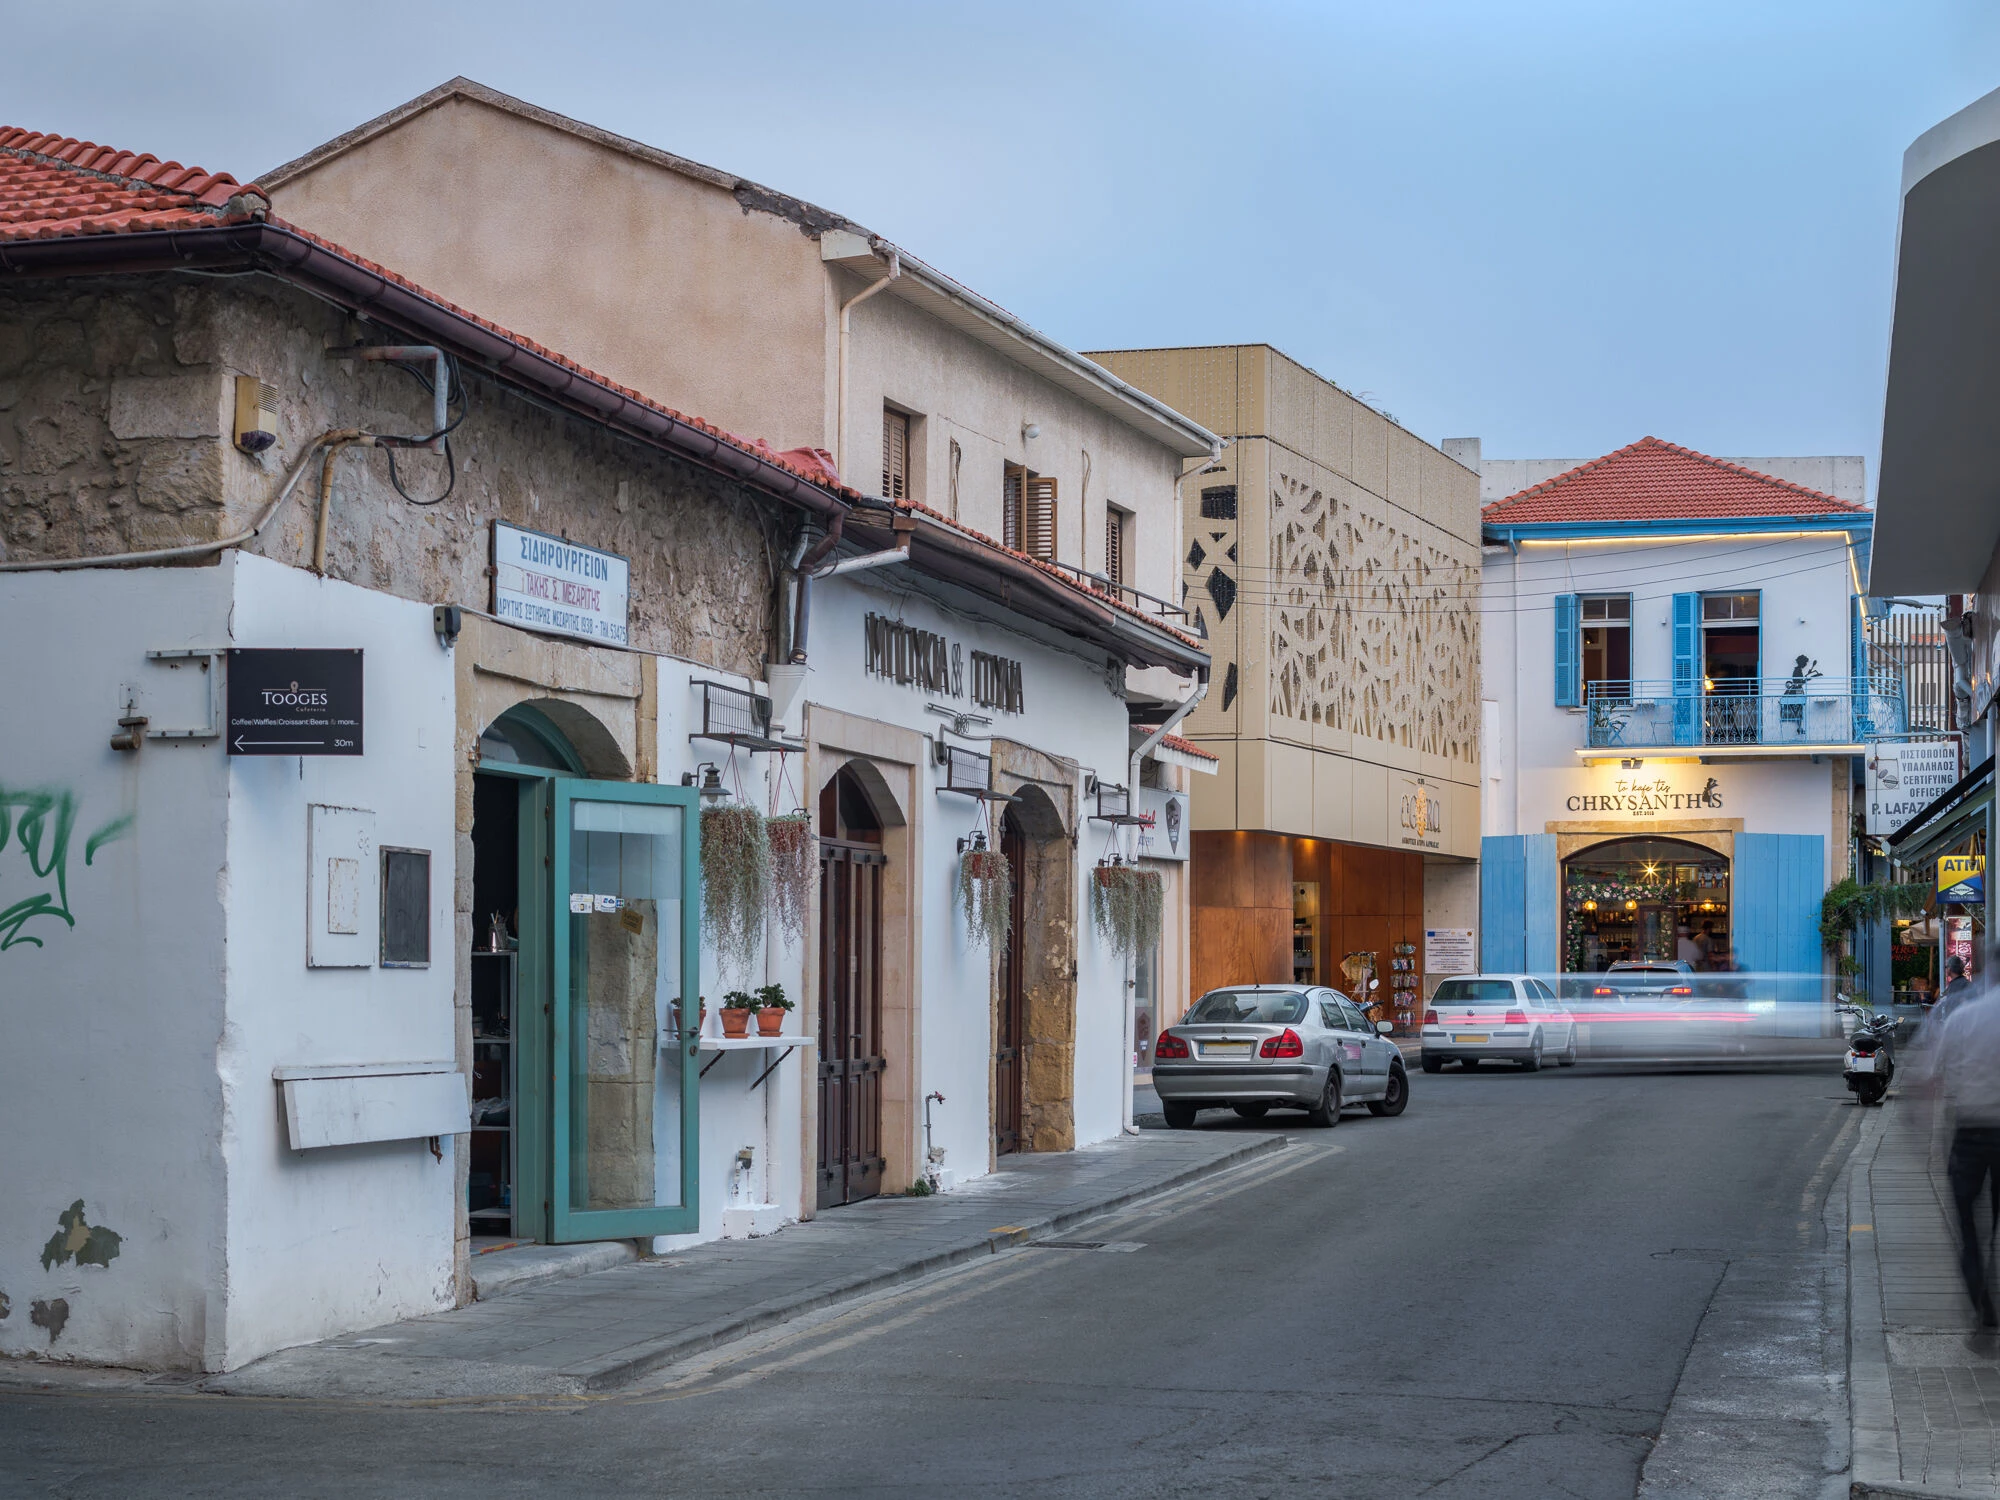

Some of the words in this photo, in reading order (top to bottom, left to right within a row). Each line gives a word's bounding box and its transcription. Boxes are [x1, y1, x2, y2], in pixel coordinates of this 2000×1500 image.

[520, 535, 608, 582] ΣΙΔΗΡΟΥΡΓΕΙΟΝ
[526, 572, 549, 598] ΤΑΚΗΣ
[562, 581, 601, 612] ΜΕΣΑΡΙΤΗΣ
[261, 691, 328, 705] TOOGES
[334, 738, 354, 748] 30m
[1900, 748, 1955, 759] ΠΙΣΤΟΠΟΙΩΝ
[1903, 774, 1953, 784] CERTIFYING
[1909, 787, 1947, 798] OFFICER
[1567, 793, 1723, 811] CHRYSANTHS
[1943, 859, 1981, 872] ATM
